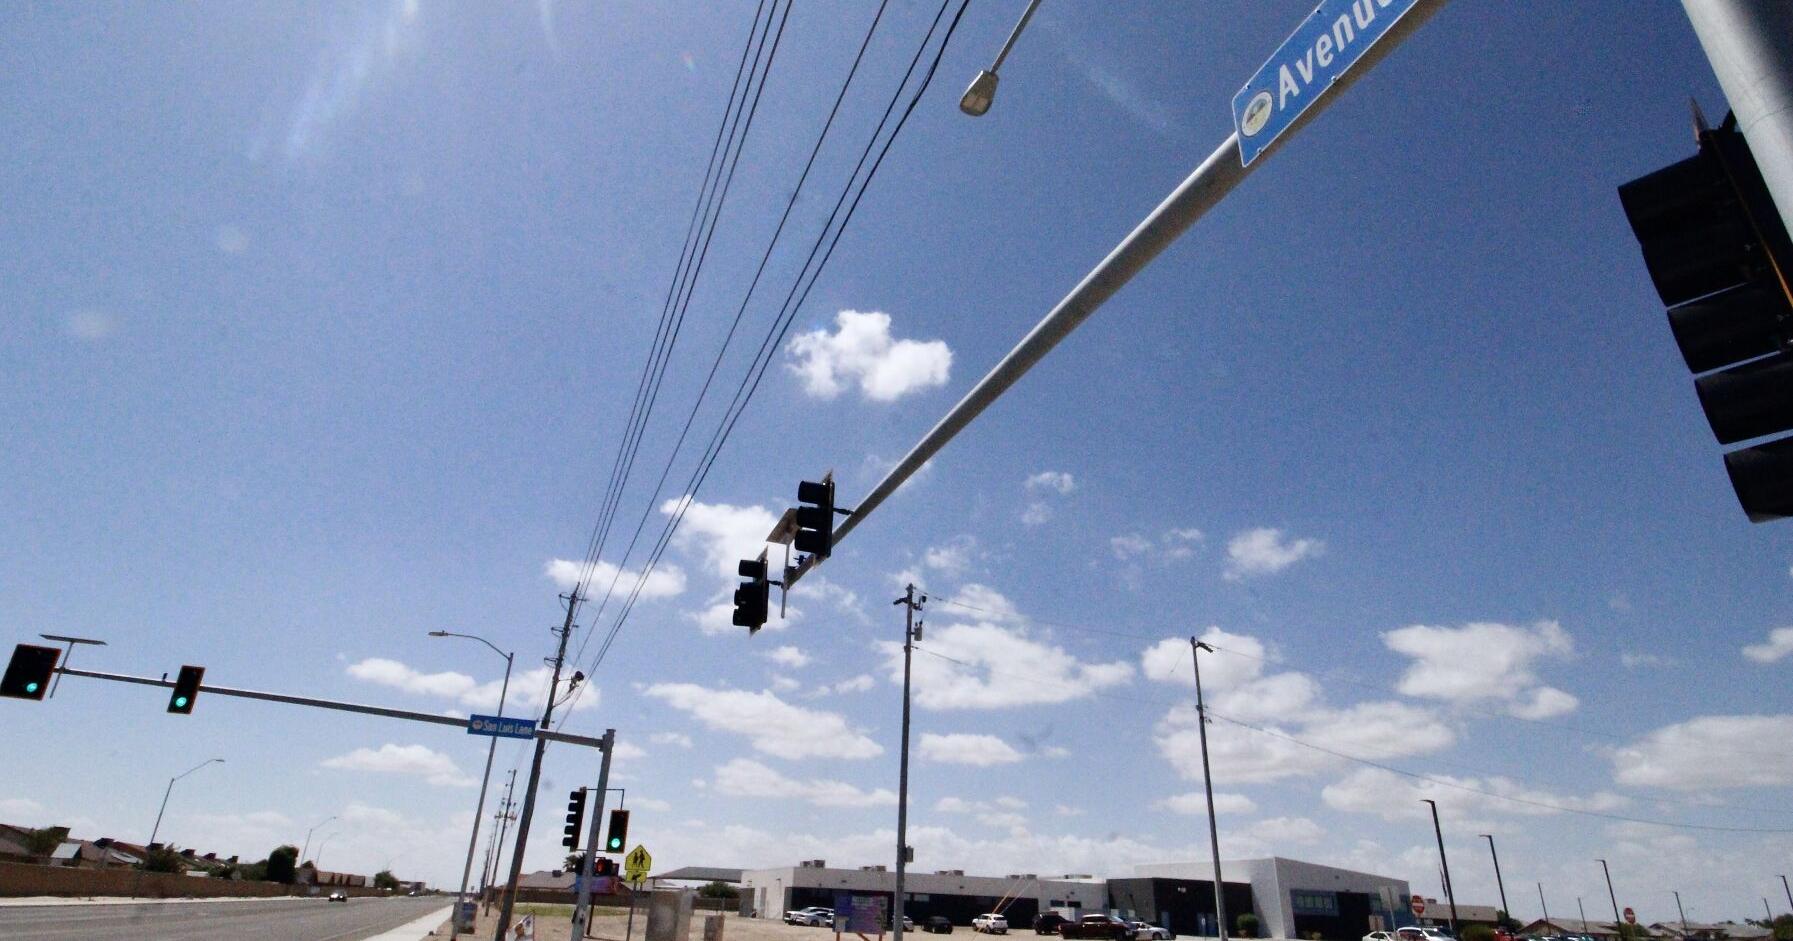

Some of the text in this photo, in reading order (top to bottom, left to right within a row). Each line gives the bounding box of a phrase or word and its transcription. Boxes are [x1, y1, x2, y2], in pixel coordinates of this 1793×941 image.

[1279, 0, 1393, 111] Avenu
[483, 719, 497, 732] San
[514, 723, 533, 735] Lane
